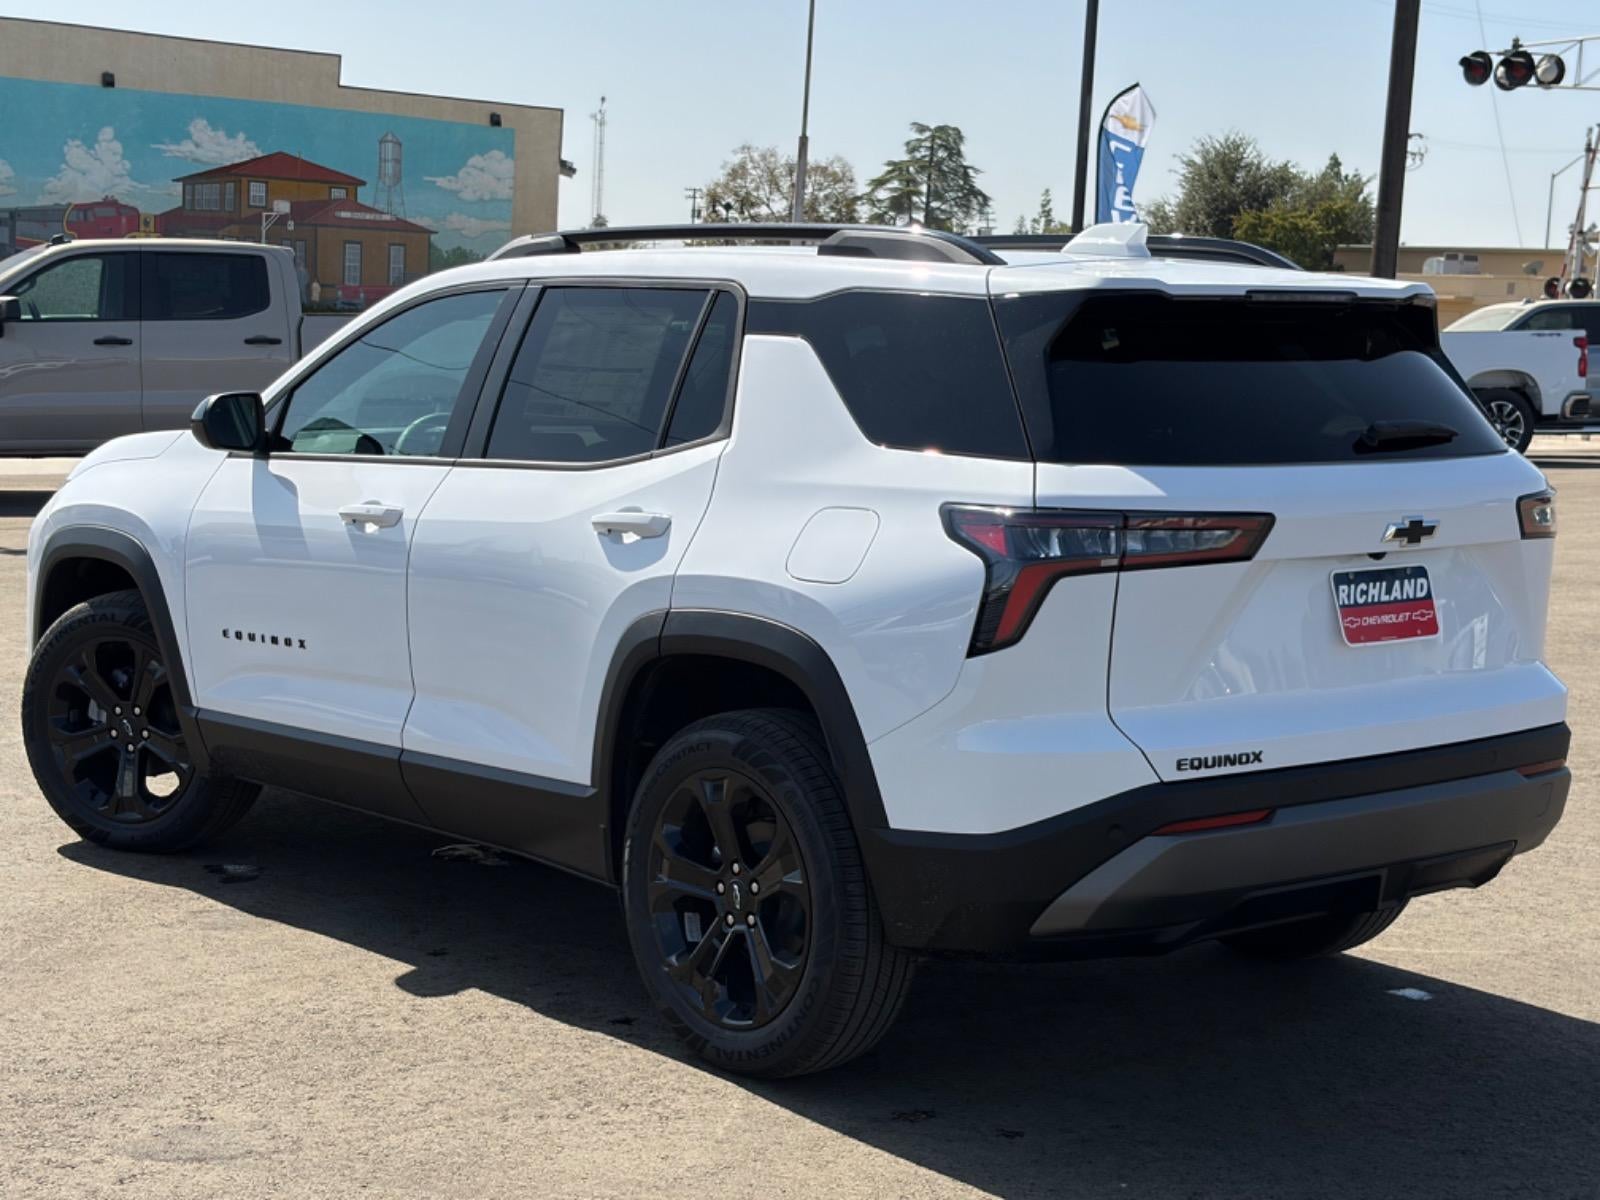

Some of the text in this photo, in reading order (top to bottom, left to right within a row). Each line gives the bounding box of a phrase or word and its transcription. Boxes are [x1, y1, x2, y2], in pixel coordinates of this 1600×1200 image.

[1338, 578, 1428, 605] RICHLAND
[1361, 612, 1411, 626] CHEVROLET
[222, 628, 306, 649] EQUINOX
[1176, 750, 1263, 771] EQUINOX
